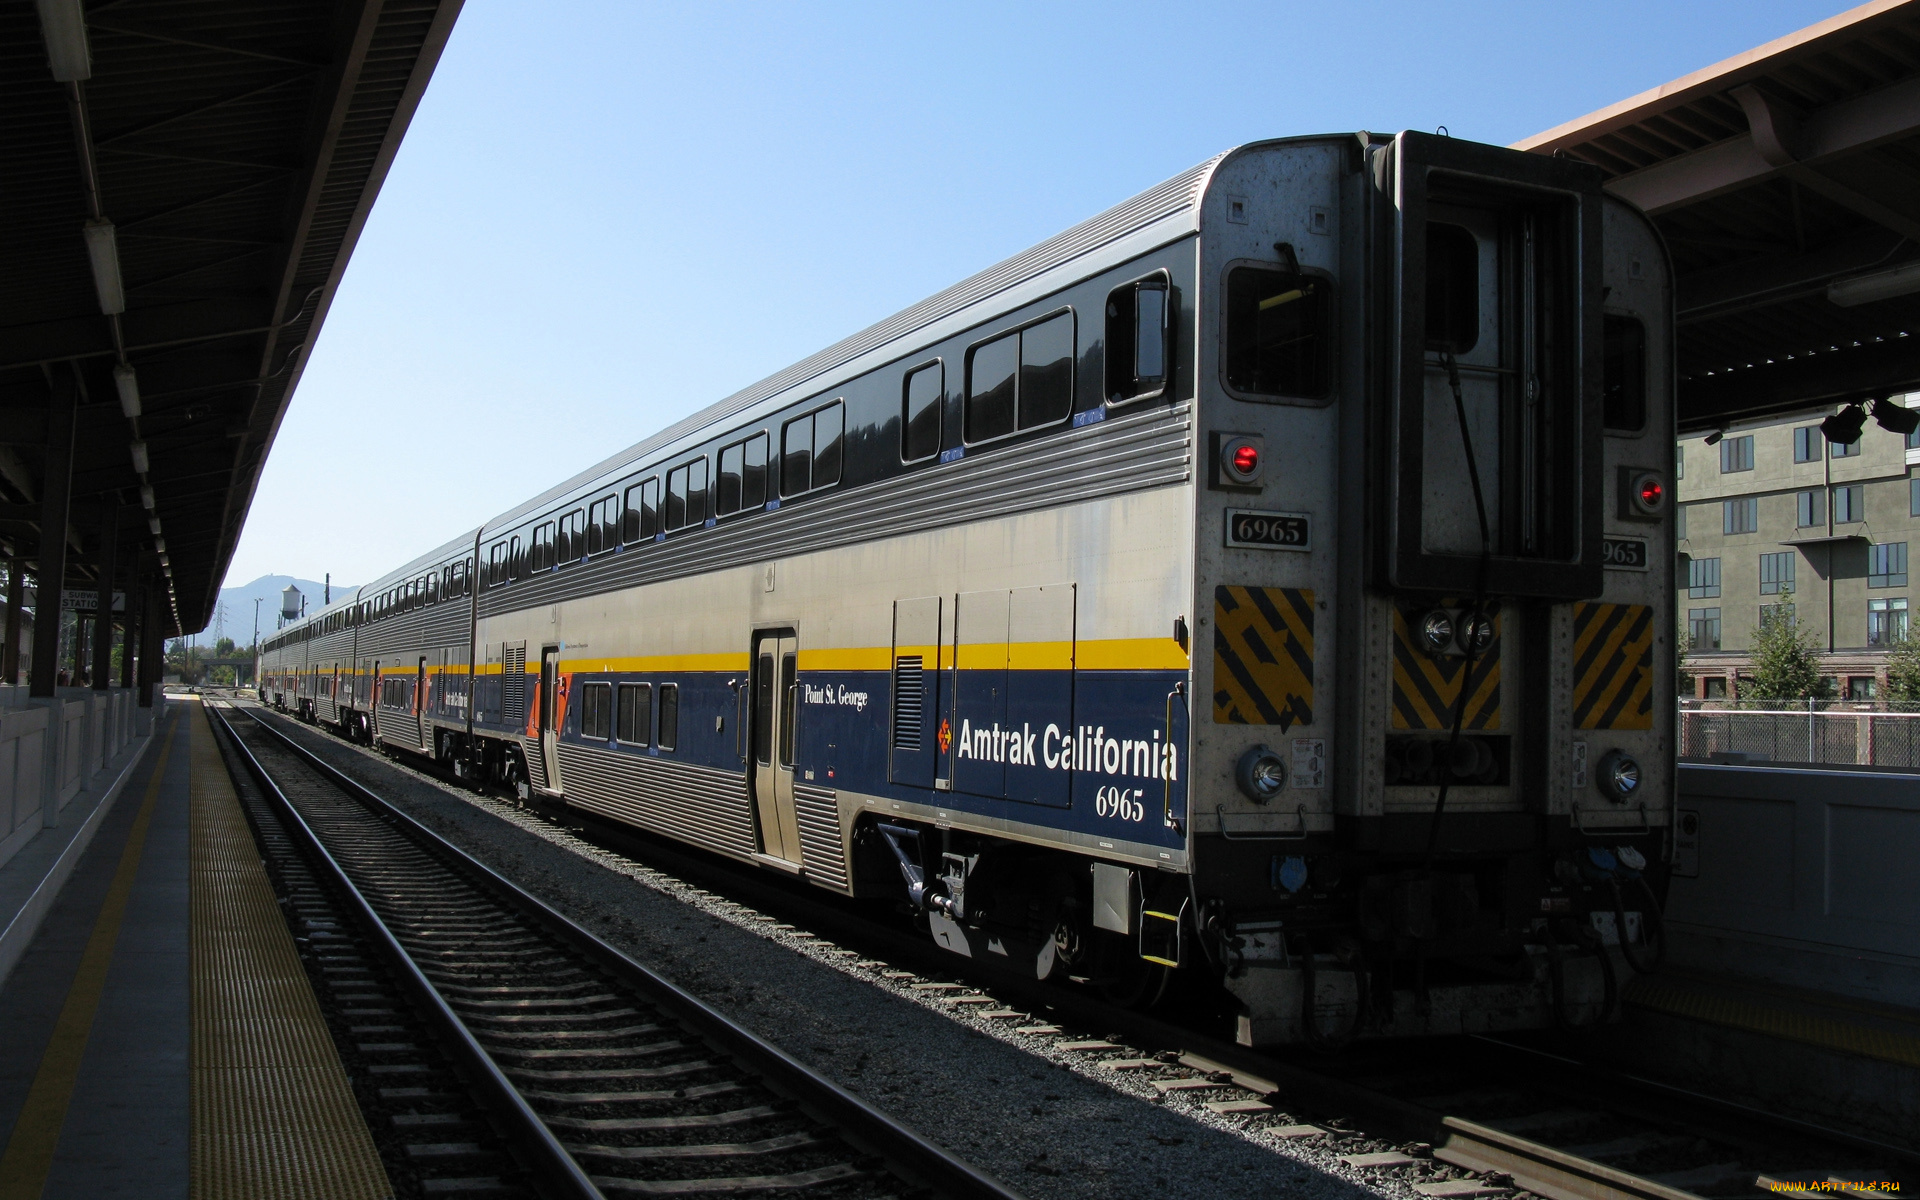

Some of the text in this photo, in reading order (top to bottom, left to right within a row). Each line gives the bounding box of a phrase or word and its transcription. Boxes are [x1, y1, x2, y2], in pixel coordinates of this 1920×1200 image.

[1238, 518, 1300, 543] 6965
[1602, 541, 1638, 564] 965
[62, 598, 98, 608] STATIO
[804, 683, 868, 712] Point St. George
[957, 718, 1178, 782] Amtrak California
[1095, 784, 1144, 823] 6965
